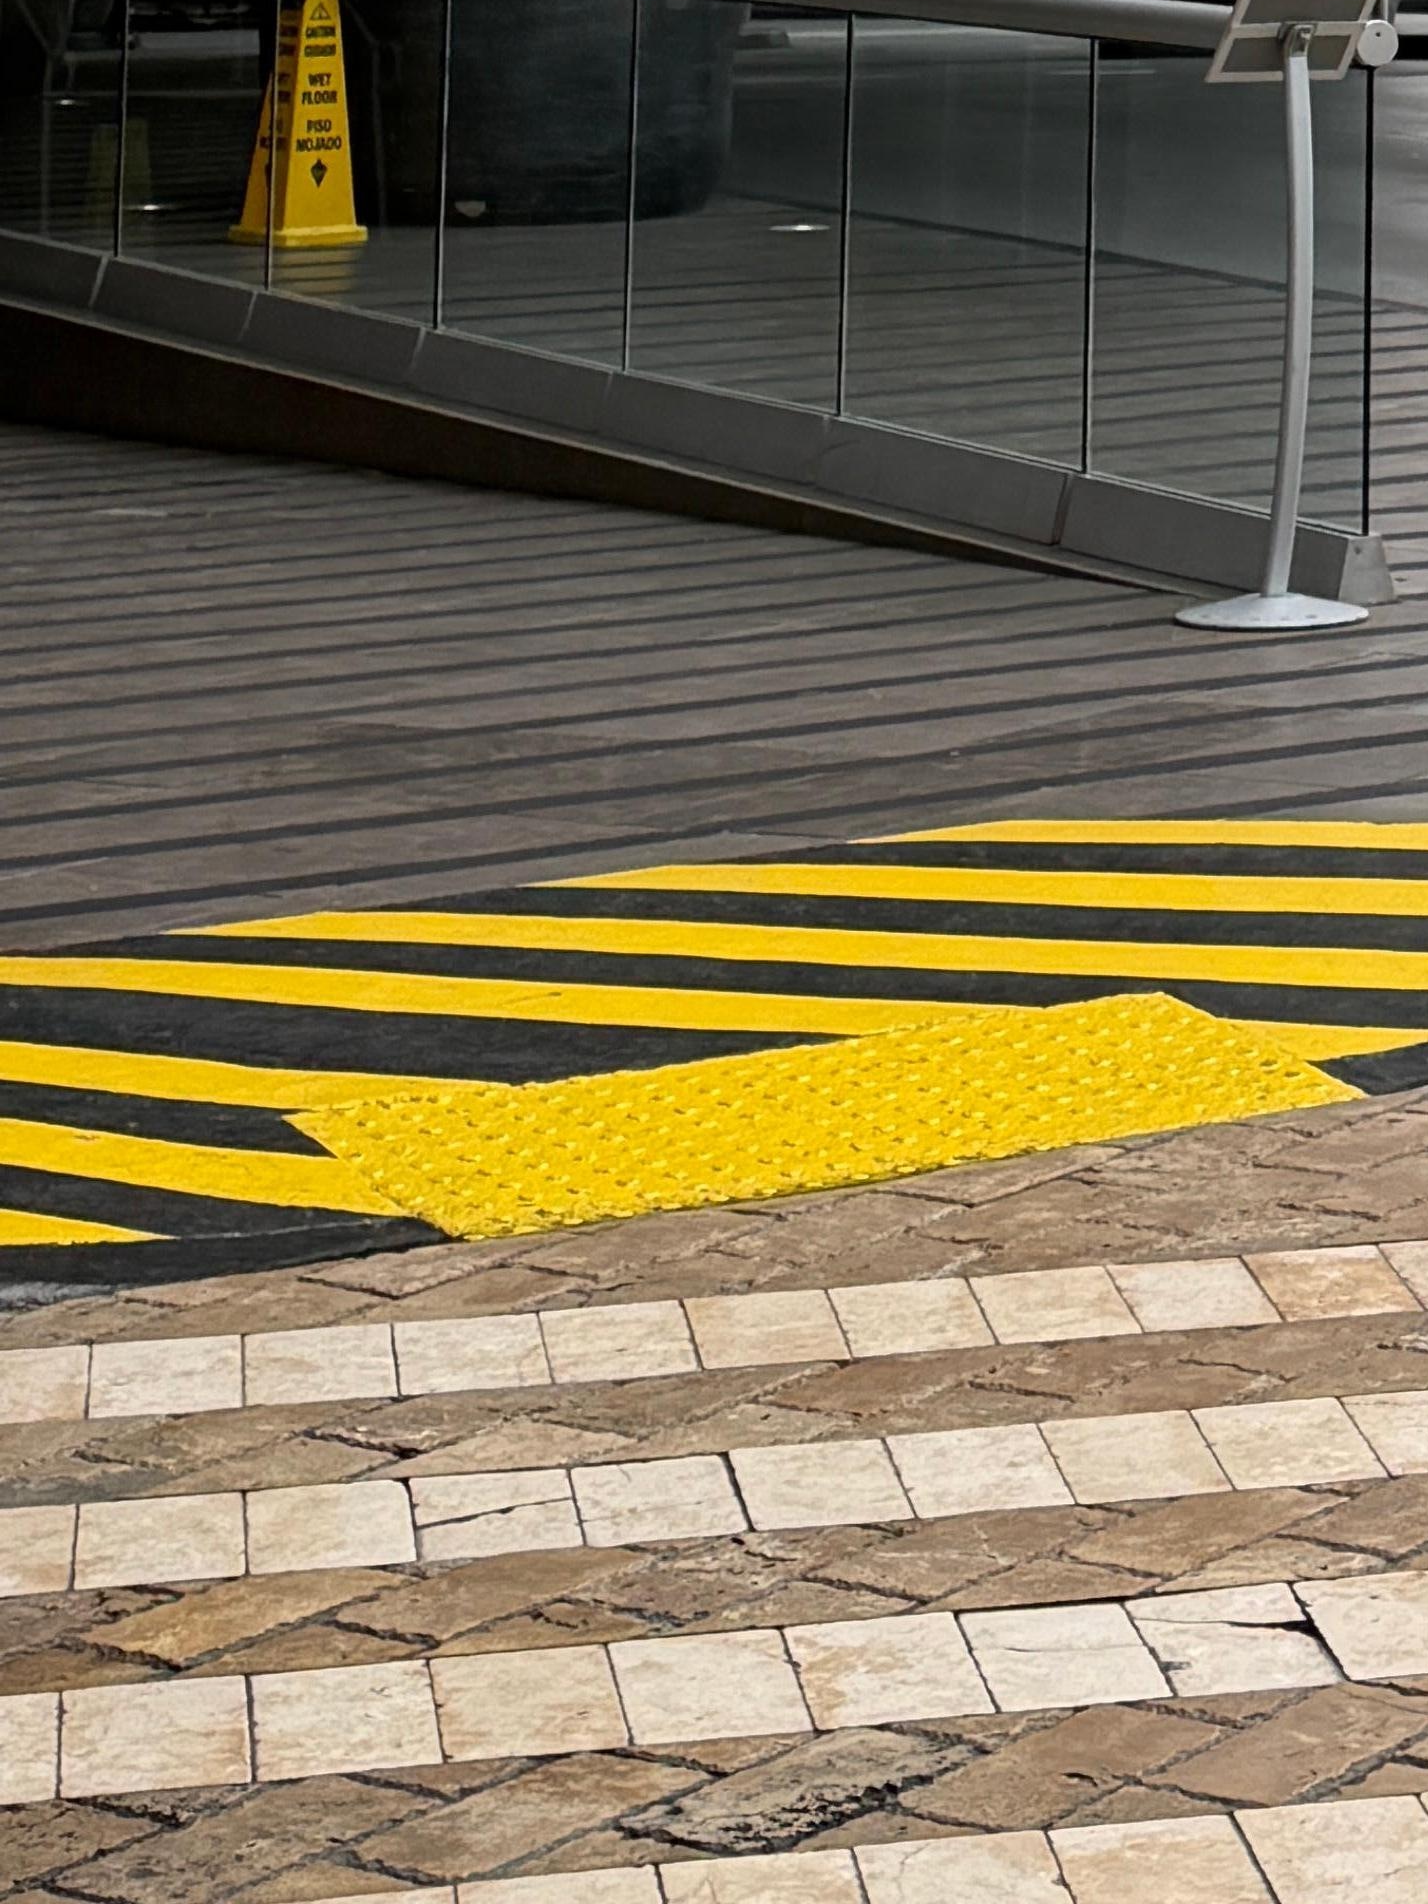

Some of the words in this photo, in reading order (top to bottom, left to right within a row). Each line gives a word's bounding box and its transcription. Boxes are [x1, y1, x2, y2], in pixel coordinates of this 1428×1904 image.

[308, 73, 332, 86] WET
[302, 90, 337, 104] FLOOR
[306, 119, 332, 133] PISO
[296, 136, 342, 152] MOJADO
